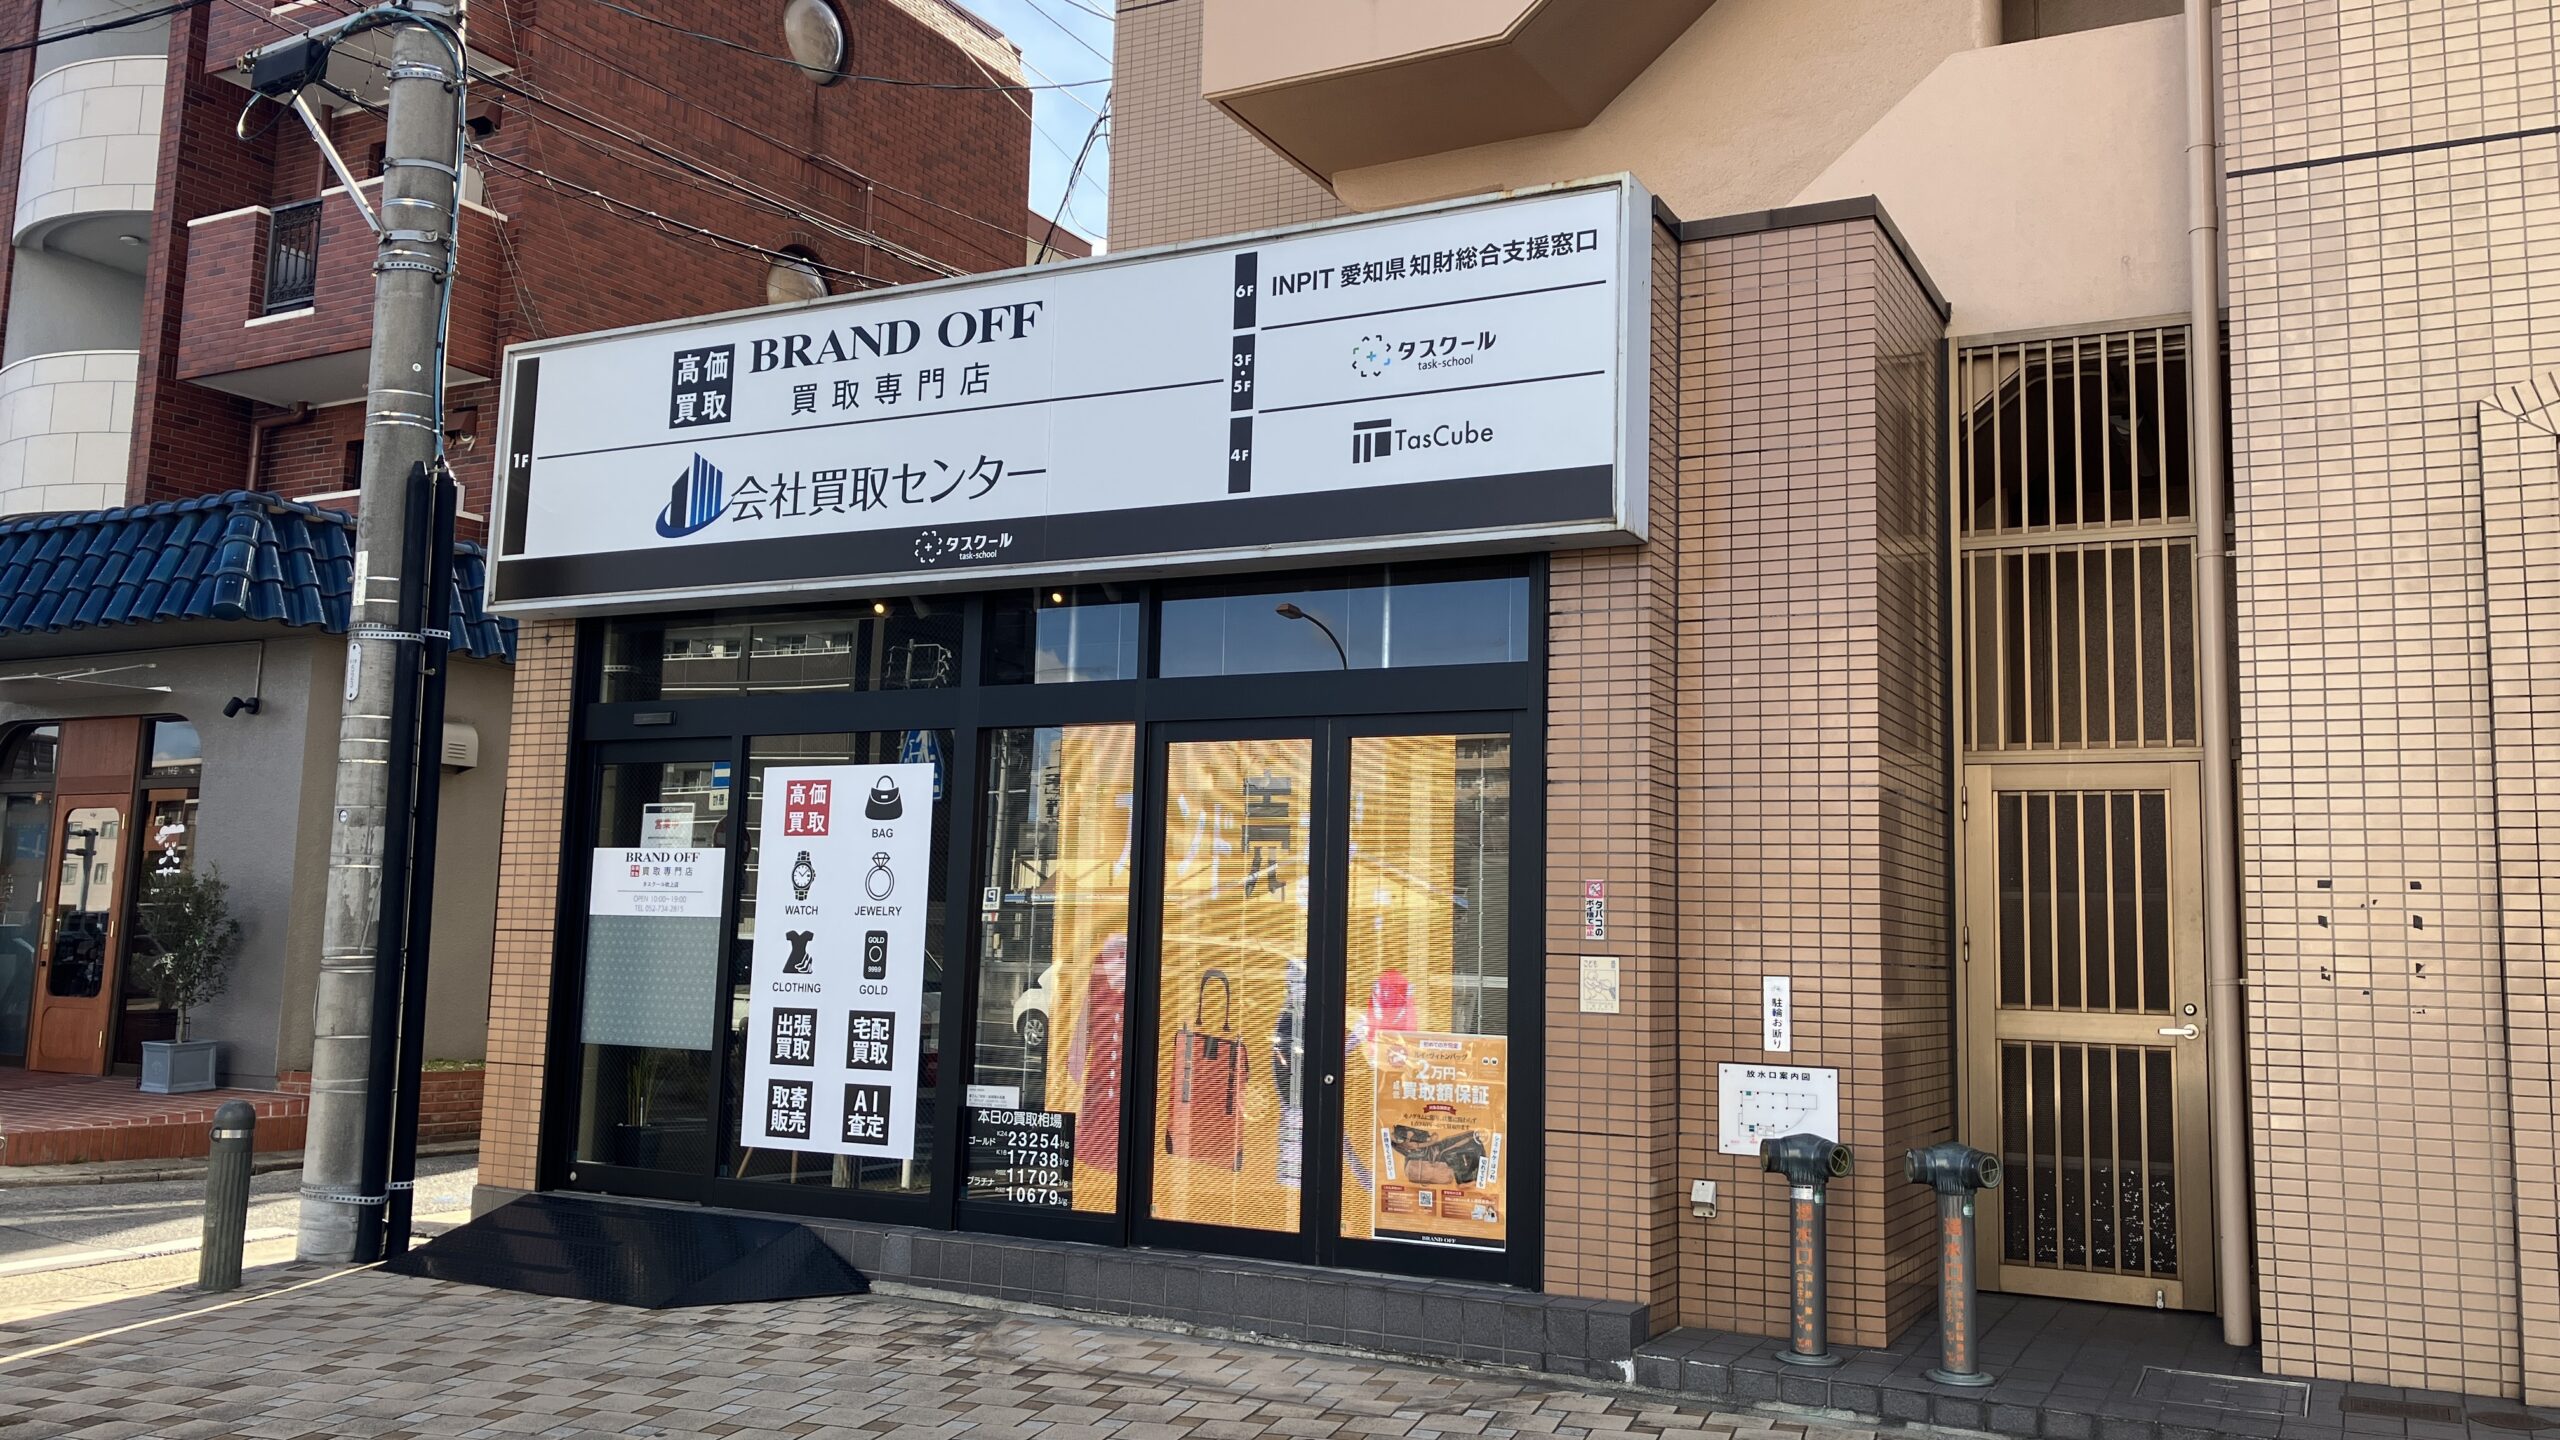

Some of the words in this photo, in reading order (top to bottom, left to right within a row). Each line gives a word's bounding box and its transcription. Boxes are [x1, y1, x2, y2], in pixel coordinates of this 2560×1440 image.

[1235, 283, 1254, 299] 6F
[1272, 268, 1335, 297] INPIT
[749, 319, 921, 373] BRAND
[938, 301, 1043, 348] OFF
[1397, 330, 1497, 361] タスクール
[677, 351, 729, 385] 高価
[1233, 353, 1252, 367] 3F
[1417, 355, 1474, 371] task-school
[791, 362, 990, 415] 買取専門店
[1233, 380, 1251, 394] 5F
[674, 390, 726, 423] 買取
[1395, 421, 1494, 451] TasCube
[513, 453, 528, 468] 1F
[1230, 448, 1249, 462] 4F
[731, 454, 1046, 523] 会社買取センター
[945, 532, 1013, 552] タスクール
[958, 549, 997, 560] task-school
[790, 783, 827, 805] 高価
[787, 811, 825, 833] 買取
[872, 828, 893, 838] BAG
[625, 852, 670, 863] BRAND
[674, 852, 700, 863] OFF
[642, 867, 693, 877] 買取専門店
[785, 905, 819, 916] WATCH
[854, 906, 902, 917] JEWELRY
[1595, 901, 1603, 937] タバコの
[868, 936, 885, 944] GOLD
[772, 982, 821, 994] CLOTHING
[859, 985, 888, 995] GOLD
[777, 1013, 812, 1038] 出張
[853, 1017, 890, 1041] 宅配
[1772, 998, 1782, 1048] 駐輪お断り
[775, 1037, 811, 1061] 買取
[852, 1041, 888, 1065] 買取
[1746, 1070, 1810, 1081] 放水口案内図
[772, 1086, 808, 1110] 取寄
[854, 1090, 880, 1112] AI
[770, 1110, 807, 1134] 販売
[848, 1114, 885, 1139] 査定
[978, 1109, 1062, 1128] 本日の買取相場
[968, 1136, 996, 1146] ゴールド
[1008, 1131, 1059, 1149] 23254
[1007, 1149, 1059, 1168] 17738
[967, 1176, 995, 1186] プラチナ
[1006, 1168, 1059, 1187] 11702
[1006, 1186, 1058, 1205] 10679
